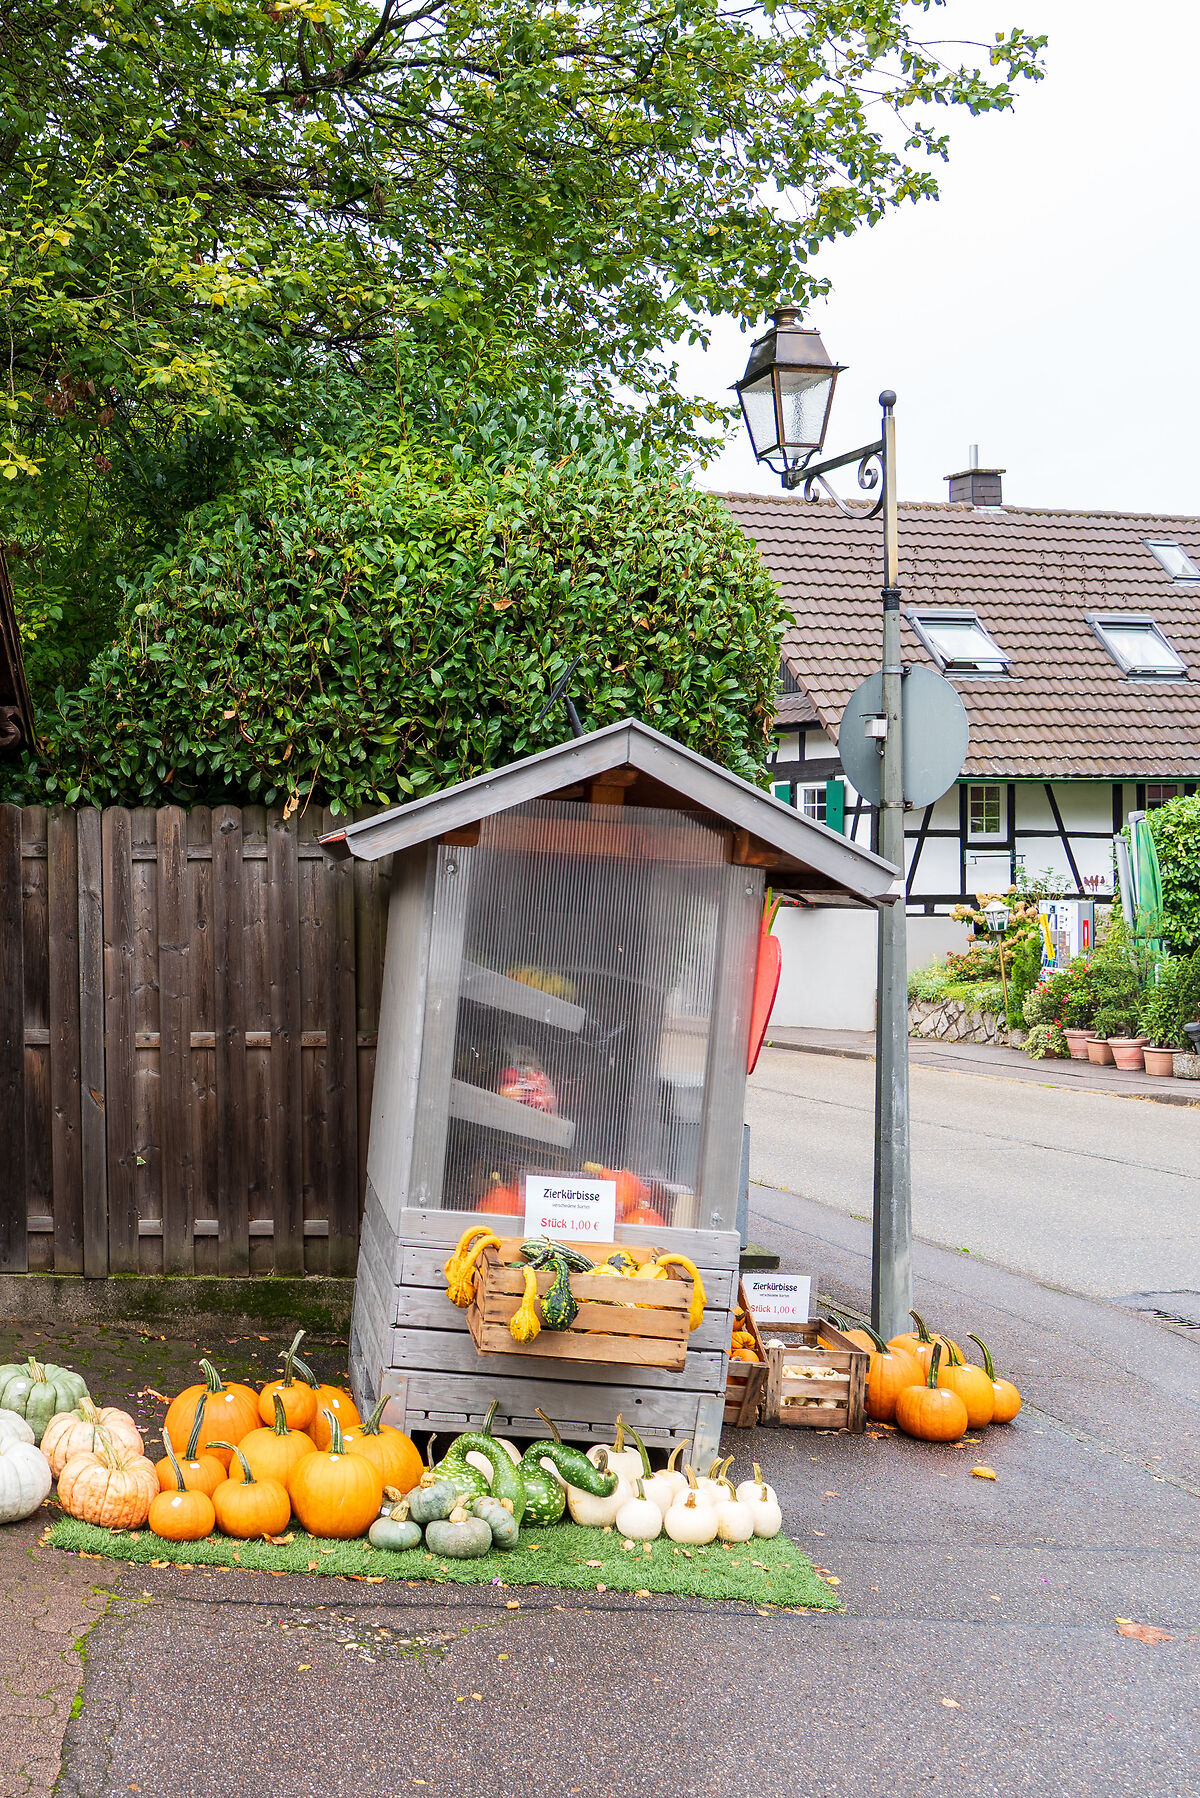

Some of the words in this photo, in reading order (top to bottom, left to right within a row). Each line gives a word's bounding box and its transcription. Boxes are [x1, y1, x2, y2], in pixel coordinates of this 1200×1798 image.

[543, 1188, 600, 1201] Zierkürbisse
[541, 1218, 566, 1228] Stück
[571, 1220, 590, 1230] 1,00
[594, 1221, 600, 1230] €
[753, 1283, 797, 1291] Zierkürbisse
[750, 1304, 771, 1313] Stück
[773, 1305, 790, 1314] 1,00
[792, 1306, 798, 1314] €
